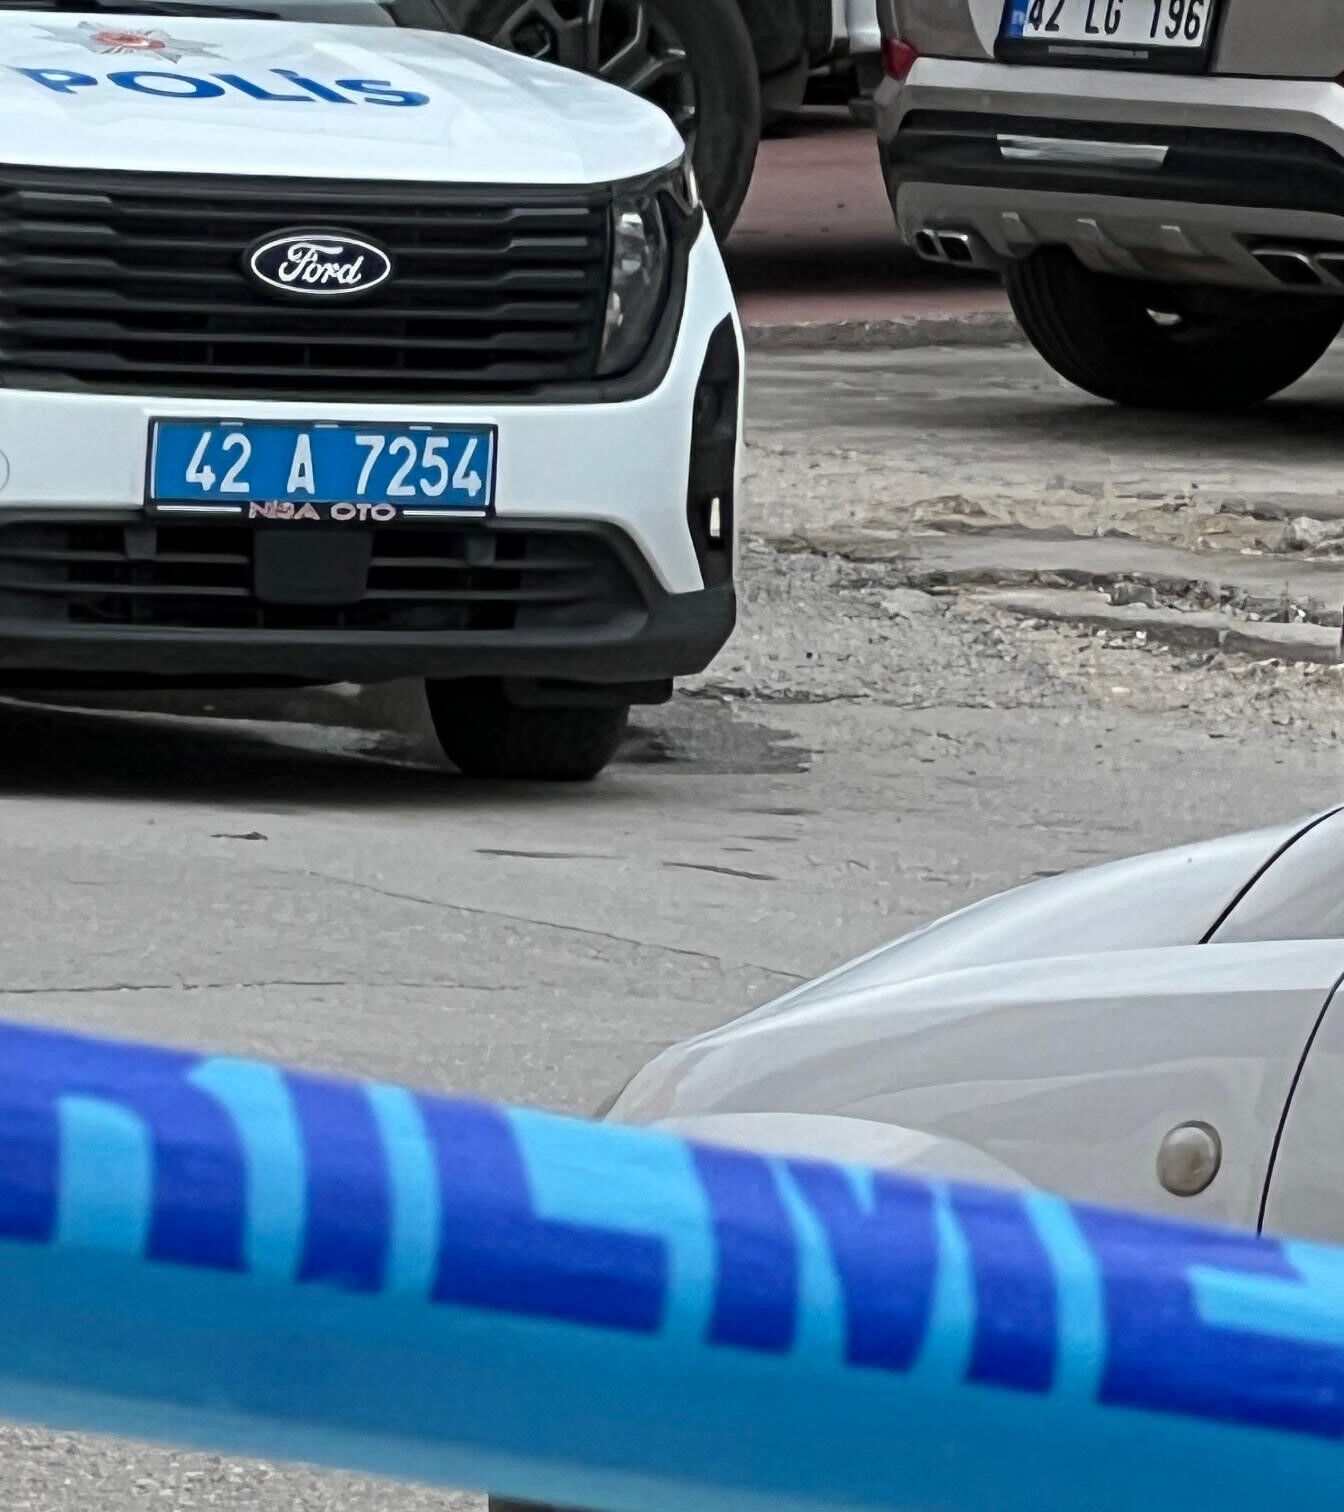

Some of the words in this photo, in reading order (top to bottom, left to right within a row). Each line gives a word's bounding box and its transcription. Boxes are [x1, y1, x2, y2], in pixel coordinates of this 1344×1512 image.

[7, 67, 431, 107] POLİS
[278, 242, 365, 285] Ford
[185, 431, 252, 493] 42
[286, 433, 316, 495] A
[354, 435, 482, 498] 7254
[330, 502, 397, 522] OTO
